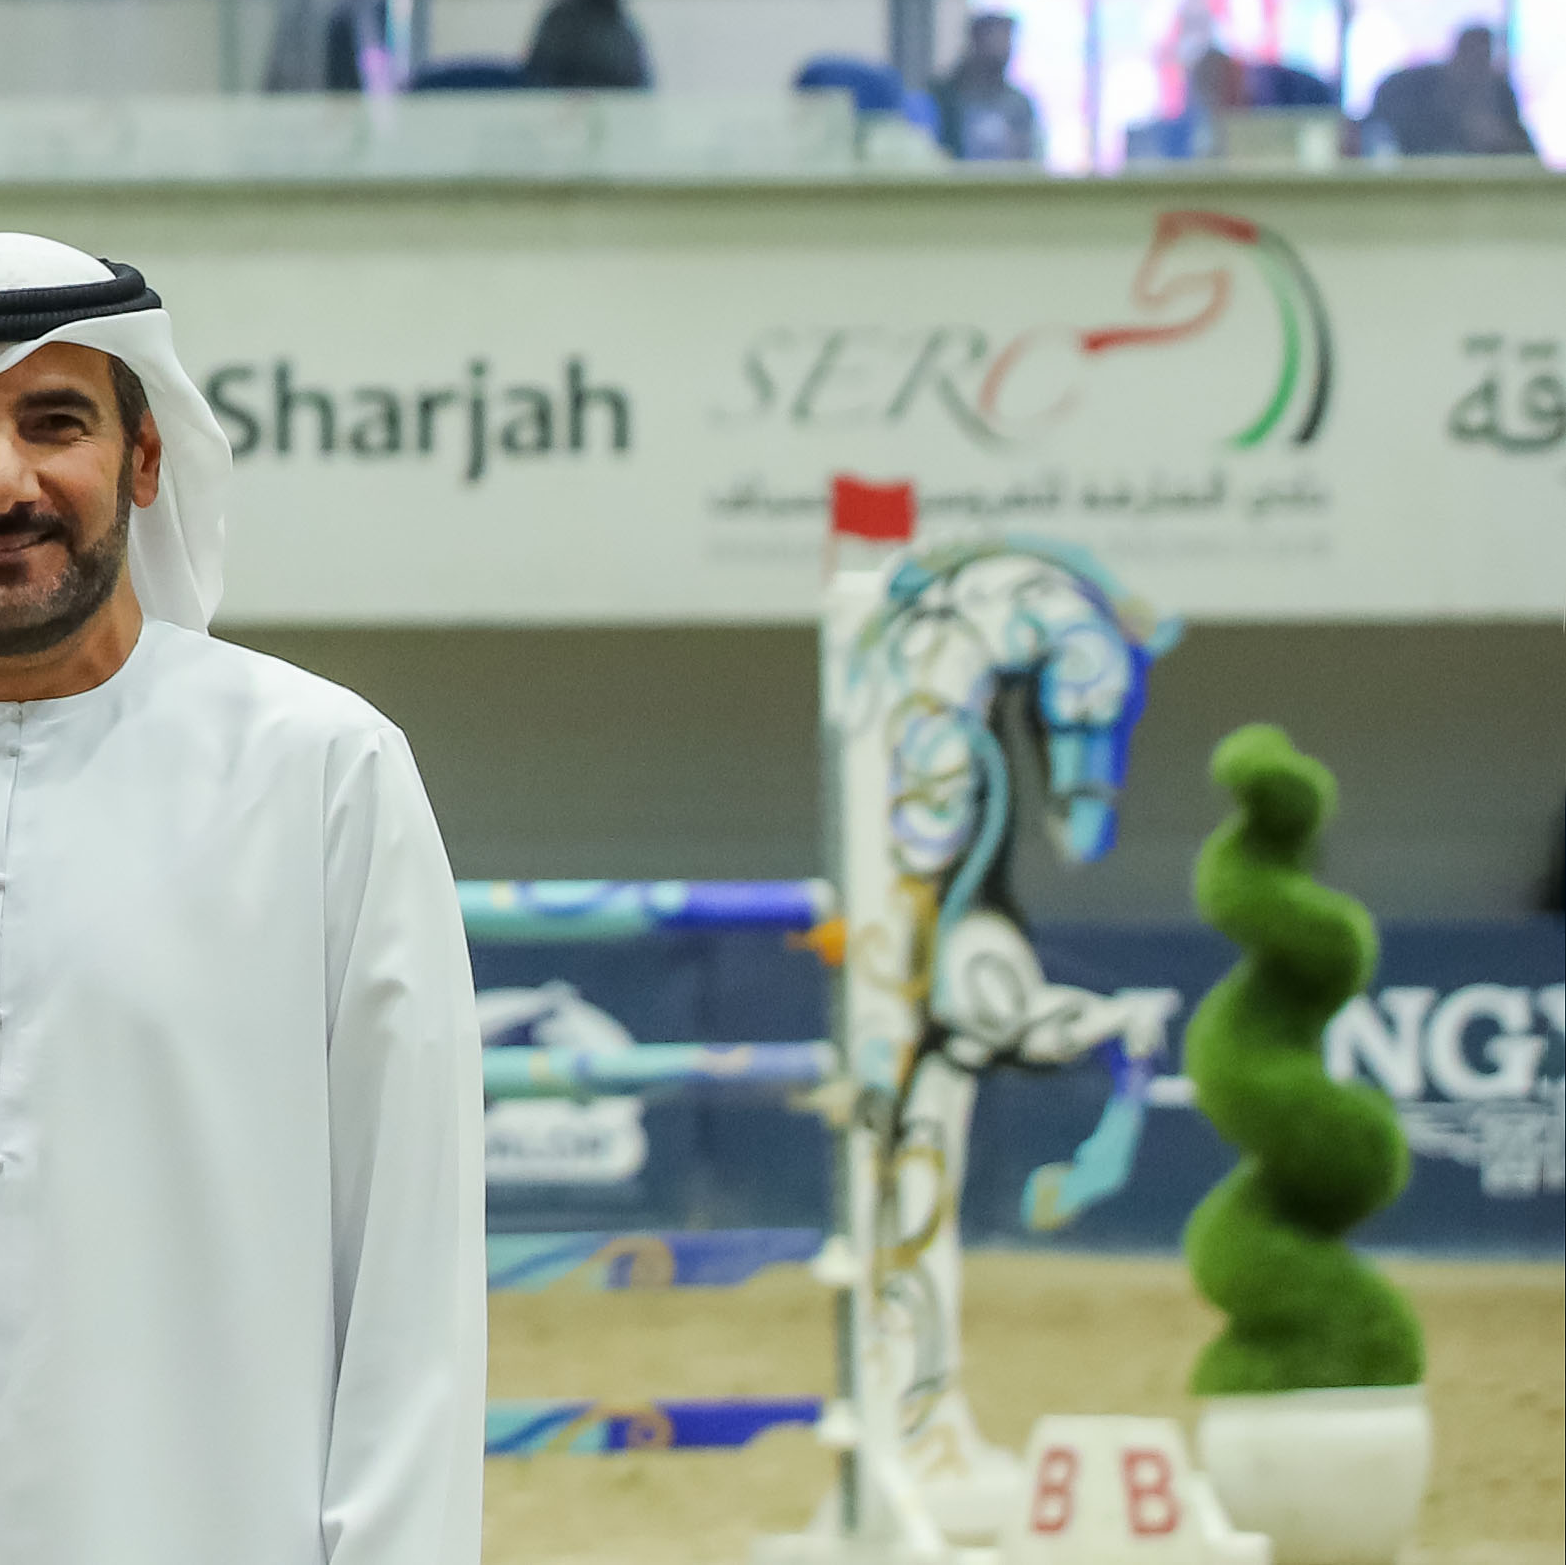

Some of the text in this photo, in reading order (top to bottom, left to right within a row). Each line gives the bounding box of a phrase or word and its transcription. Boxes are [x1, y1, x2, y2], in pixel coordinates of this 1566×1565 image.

[204, 357, 631, 484] Sharjah
[1029, 1446, 1183, 1538] B B
